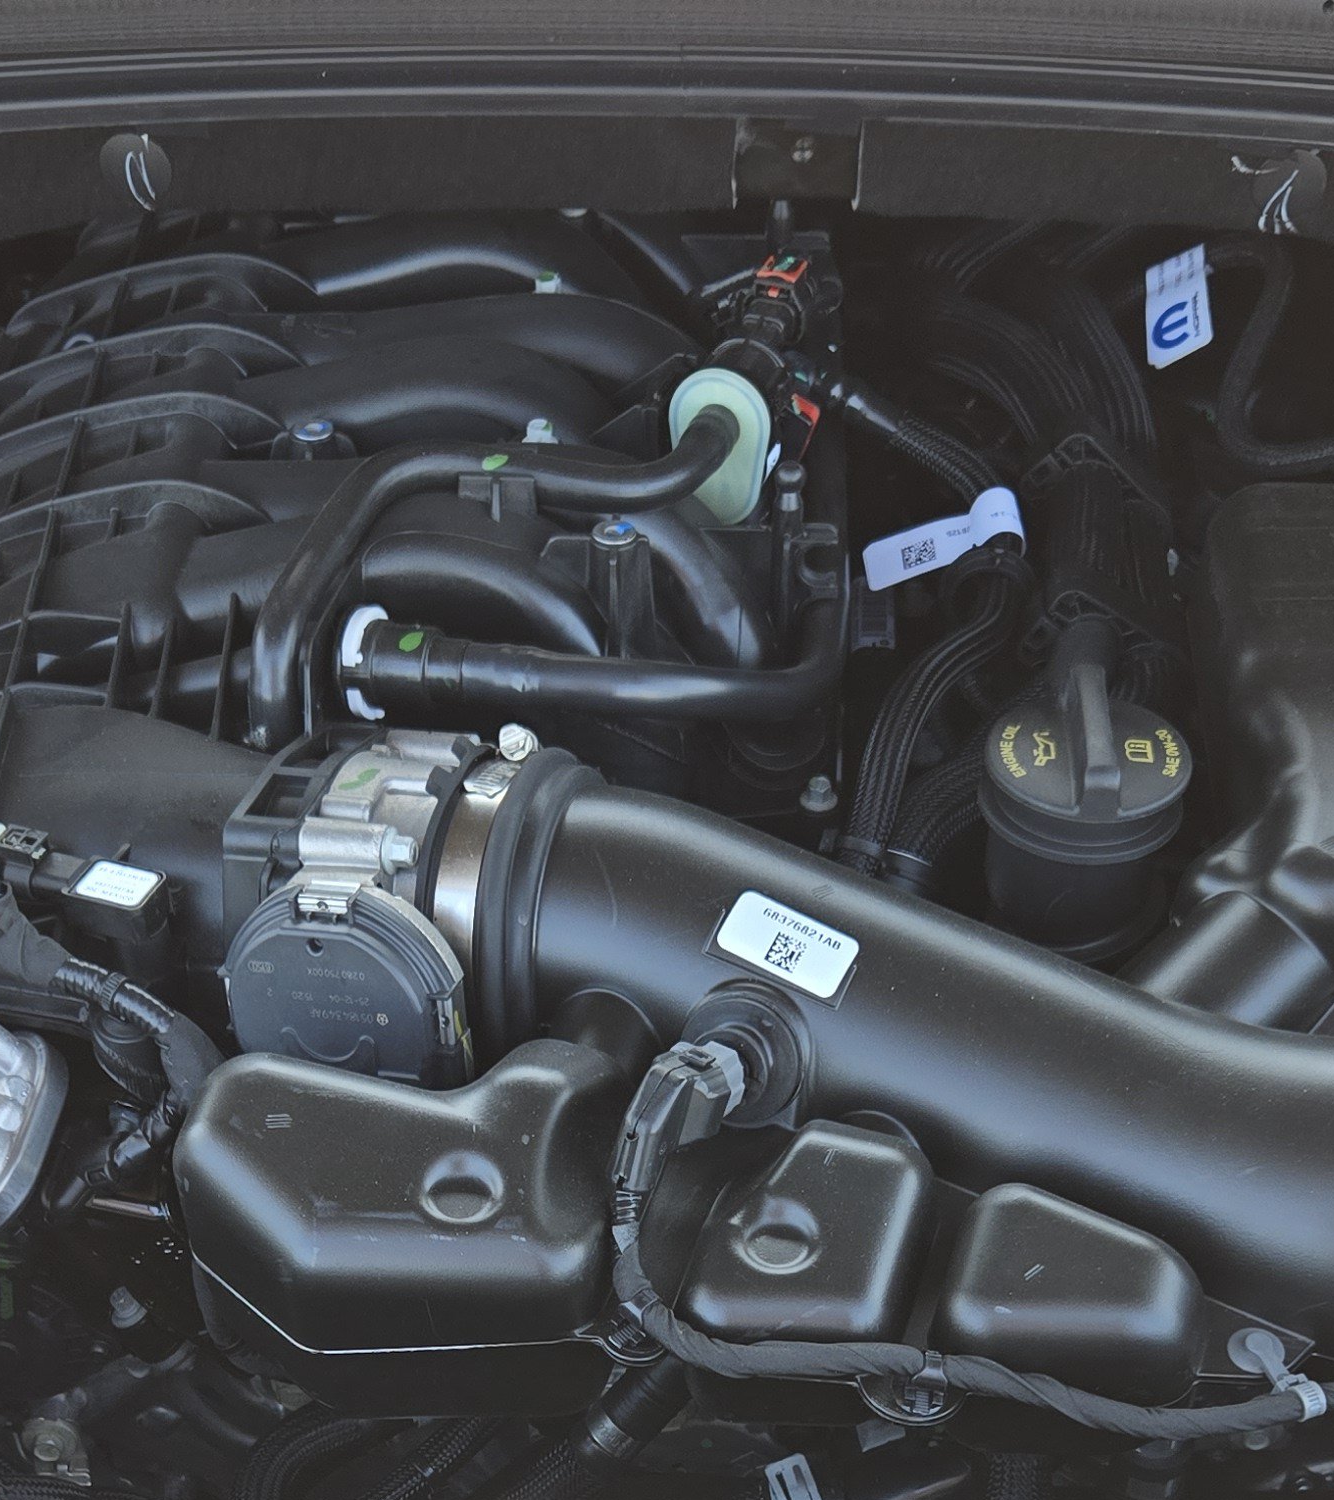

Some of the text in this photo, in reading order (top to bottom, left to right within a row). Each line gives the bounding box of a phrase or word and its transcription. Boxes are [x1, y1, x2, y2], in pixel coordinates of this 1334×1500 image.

[999, 724, 1027, 778] ENGINE OIL
[1161, 757, 1181, 778] SAE
[762, 907, 842, 951] 68376821AB
